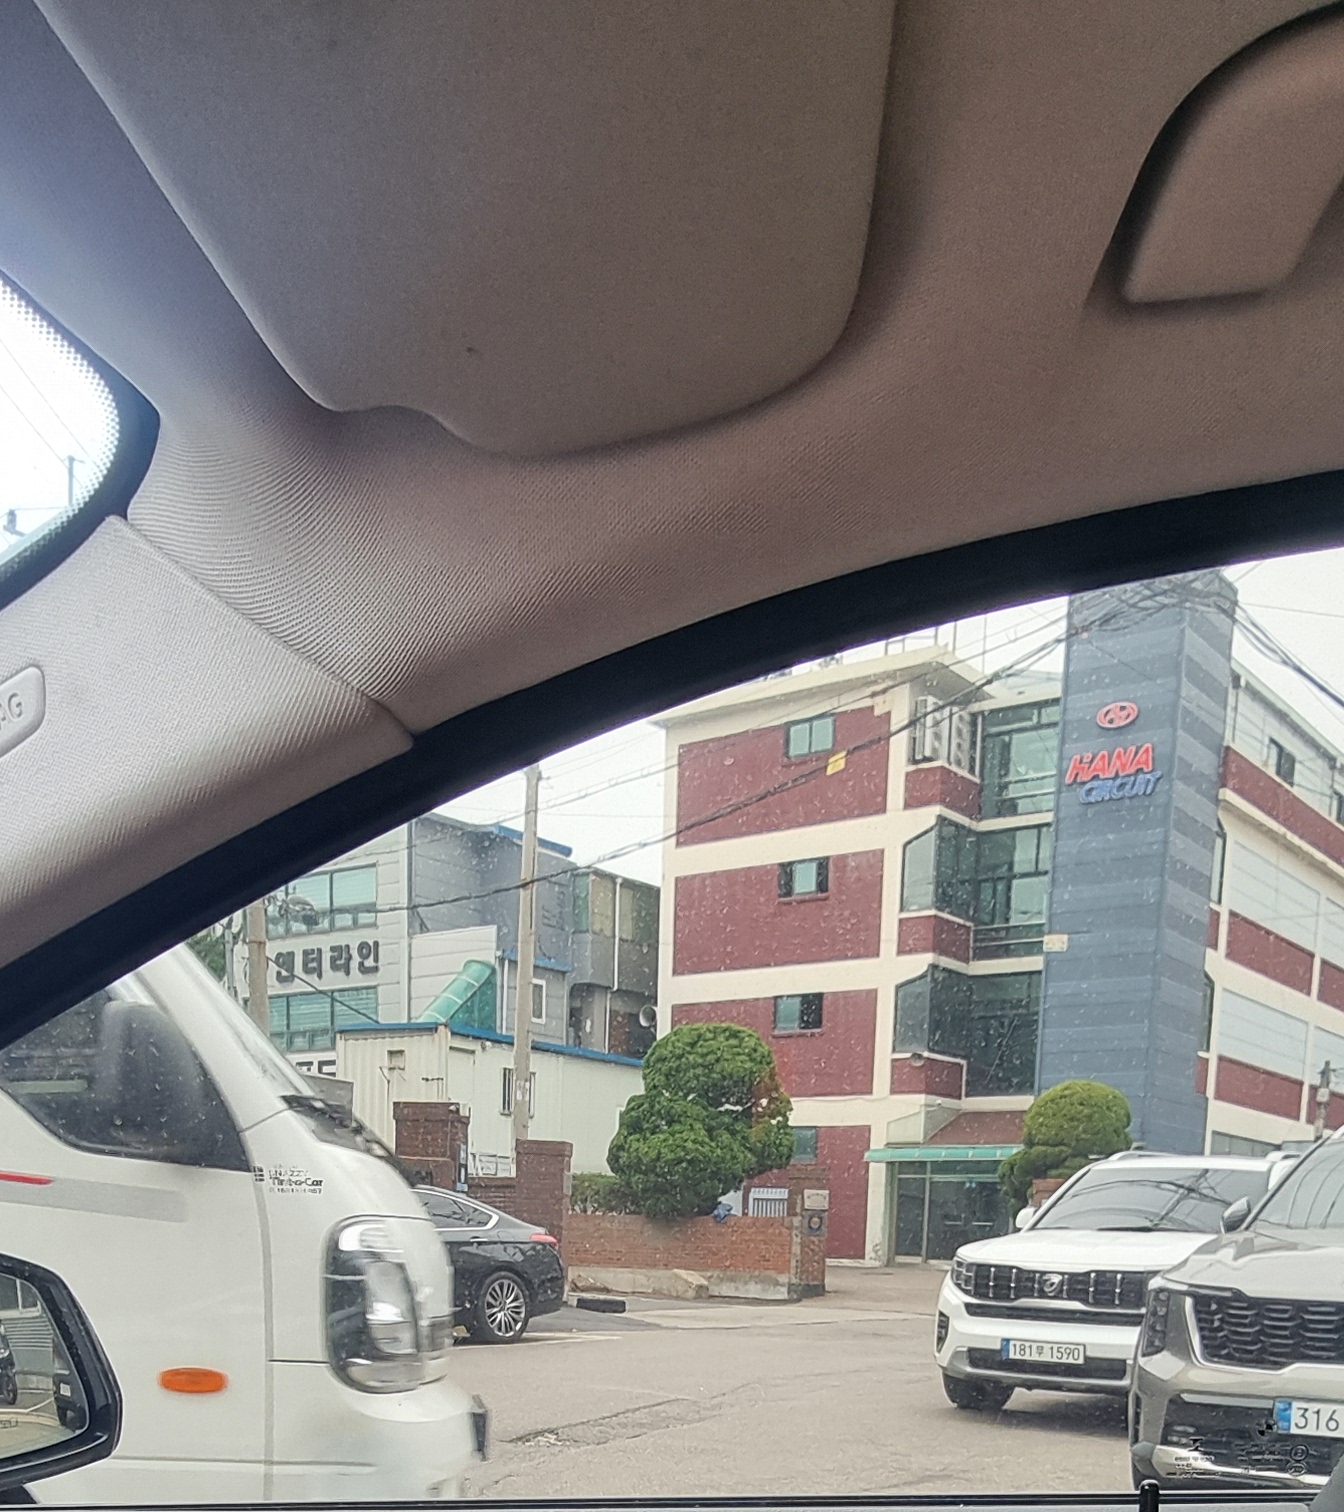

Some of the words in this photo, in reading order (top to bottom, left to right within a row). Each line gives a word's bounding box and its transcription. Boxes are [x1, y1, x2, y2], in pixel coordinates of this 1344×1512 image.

[1064, 742, 1154, 785] HANA
[1079, 770, 1163, 804] CIRCUIT
[1049, 1345, 1081, 1362] 1590
